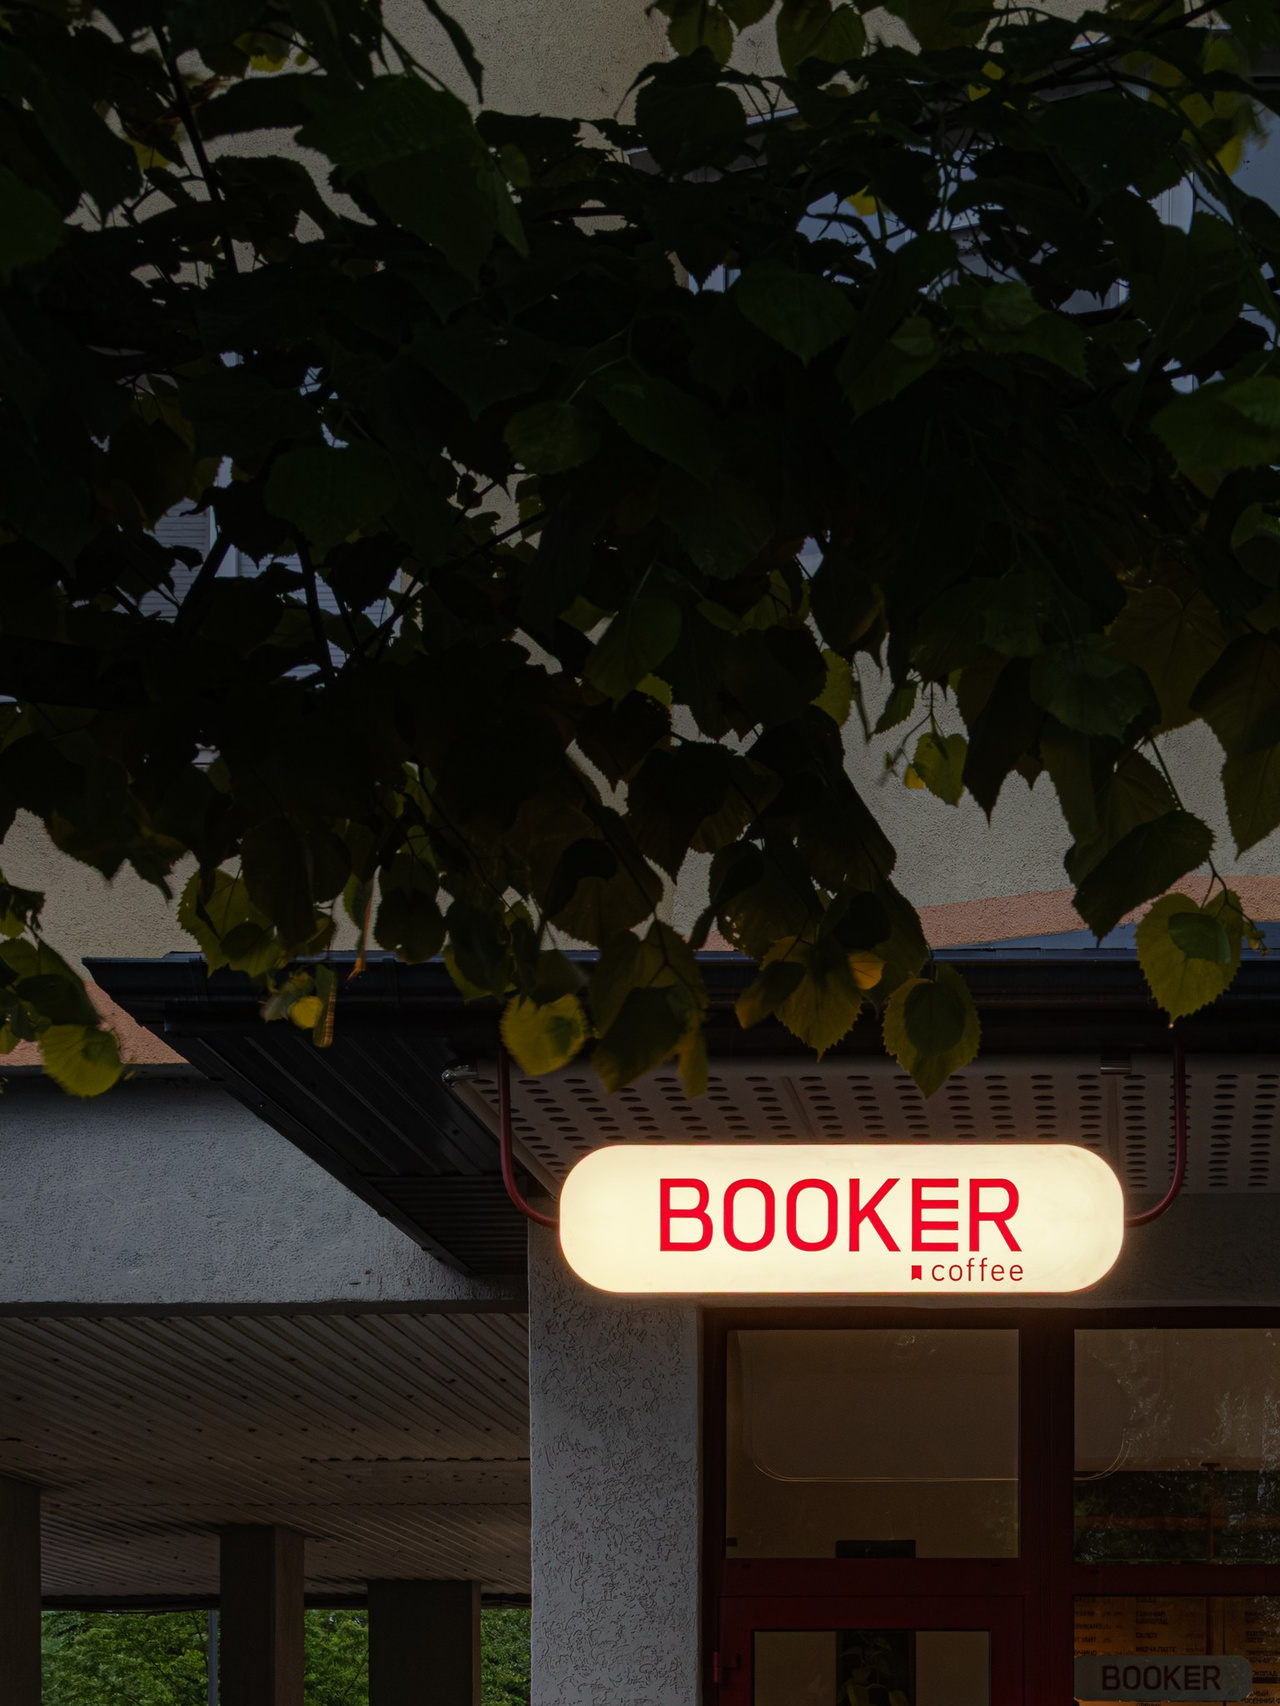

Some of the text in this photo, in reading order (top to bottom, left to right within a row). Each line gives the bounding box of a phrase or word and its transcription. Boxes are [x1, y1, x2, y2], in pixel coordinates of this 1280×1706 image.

[659, 1178, 1022, 1252] BOOKER
[931, 1257, 1024, 1282] coffee
[1102, 1665, 1221, 1691] BOOKER
